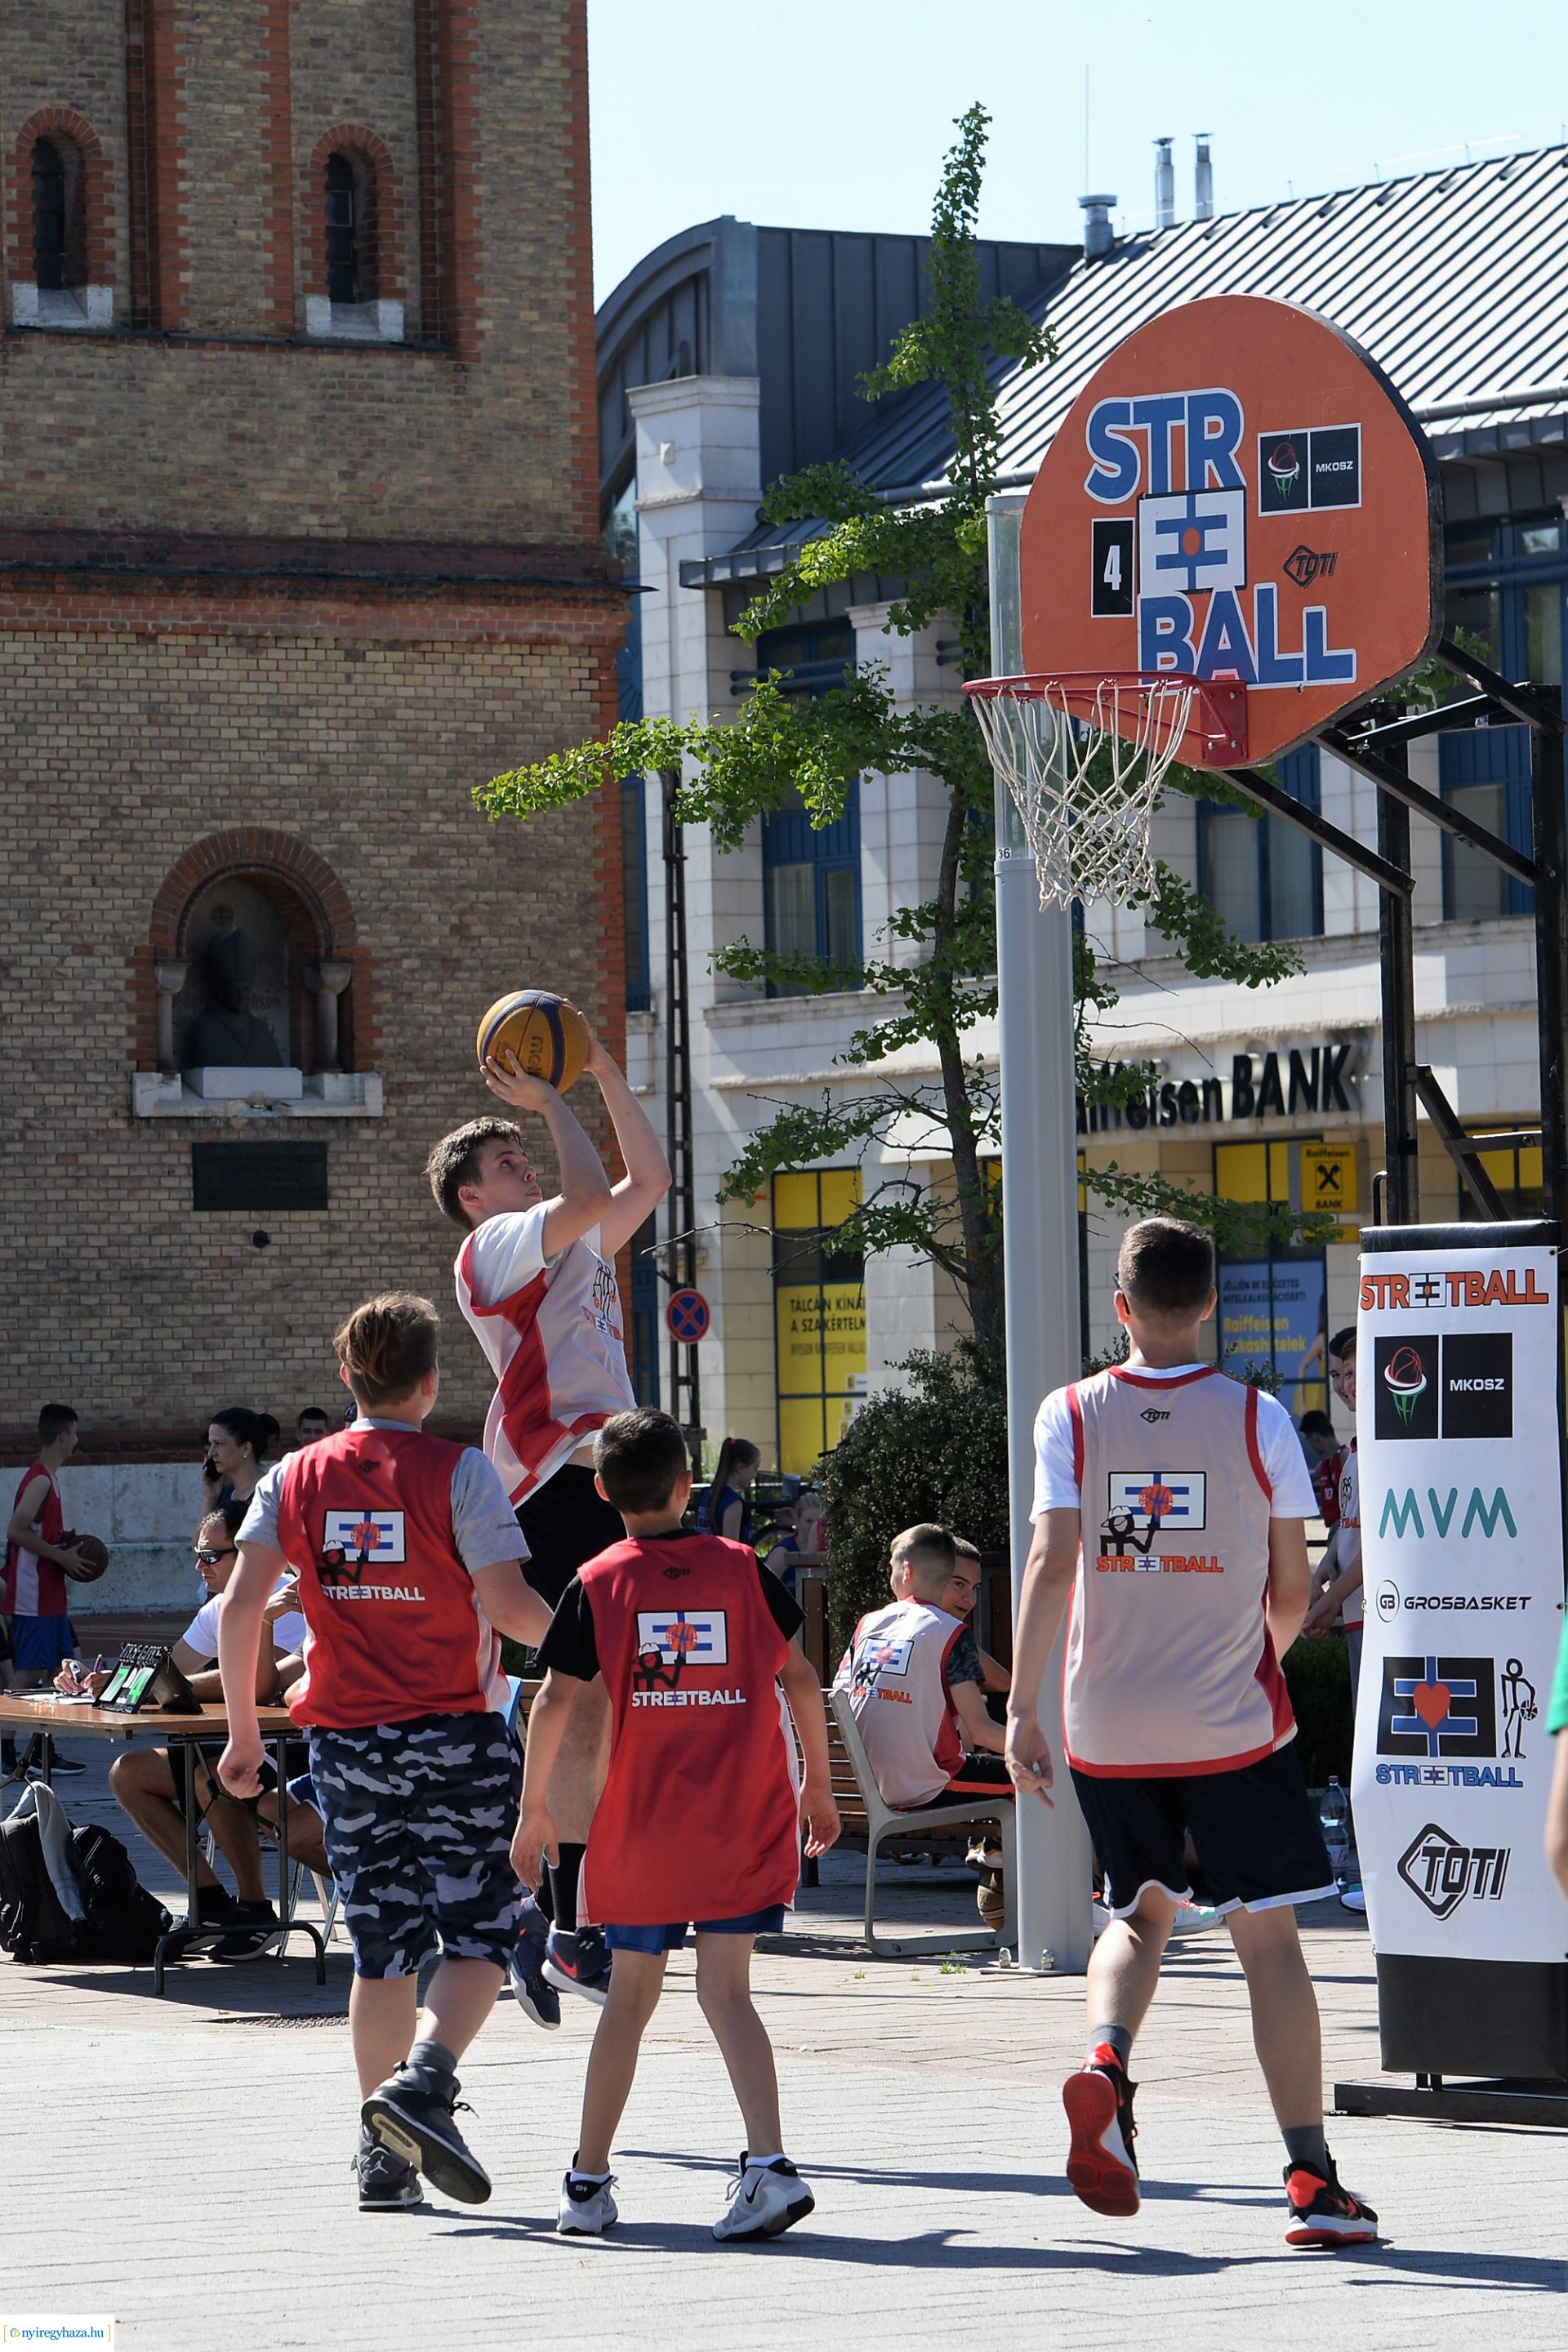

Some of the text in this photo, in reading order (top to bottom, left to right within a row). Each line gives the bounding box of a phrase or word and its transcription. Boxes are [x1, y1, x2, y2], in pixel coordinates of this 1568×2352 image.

[1315, 460, 1354, 474] MKOSZ
[1103, 545, 1122, 591] 4
[1294, 551, 1339, 578] TOTI
[1138, 581, 1358, 697] BALL
[998, 847, 1011, 860] 36
[1232, 1045, 1353, 1120] BANK
[1305, 1147, 1352, 1160] Raiffeisen
[1315, 1199, 1344, 1209] BANK
[1360, 1268, 1550, 1312] STREETBALL
[1449, 1376, 1506, 1392] MKOSZ
[1379, 1486, 1518, 1539] MVM
[1096, 1555, 1224, 1573] STREETBALL
[1404, 1595, 1533, 1611] GROSBASKET
[631, 1688, 746, 1708] STREETBALL
[1375, 1763, 1524, 1788] STREETBALL
[1419, 1845, 1512, 1901] TOTI
